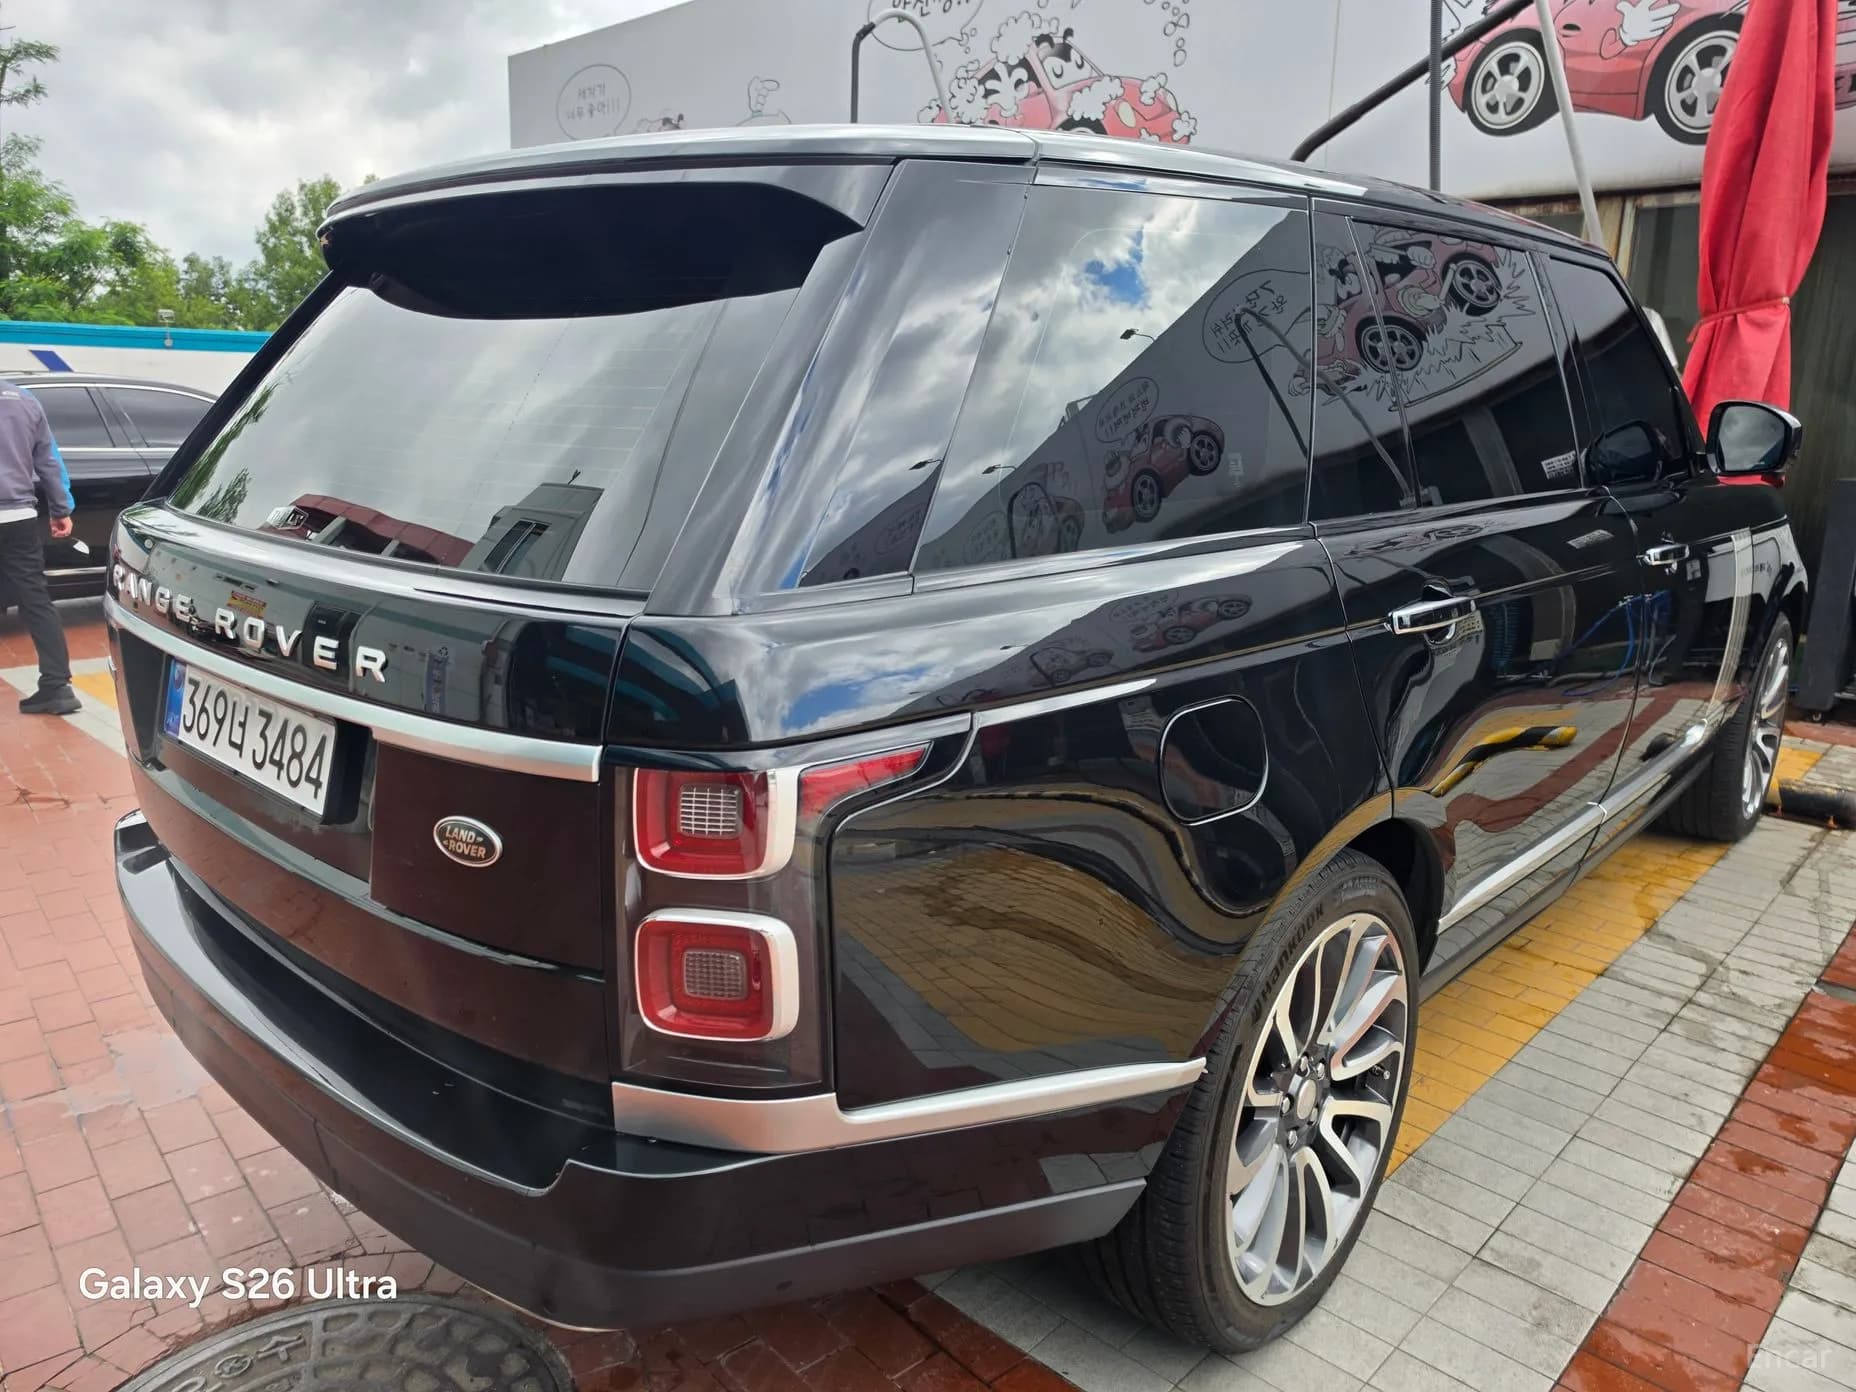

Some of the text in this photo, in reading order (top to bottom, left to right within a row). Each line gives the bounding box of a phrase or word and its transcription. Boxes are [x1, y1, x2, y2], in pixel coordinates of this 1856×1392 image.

[112, 563, 193, 622] RANGE
[214, 607, 387, 683] ROVER
[182, 677, 328, 800] 369너 3484
[445, 825, 476, 843] LAND
[448, 840, 487, 859] ROVER
